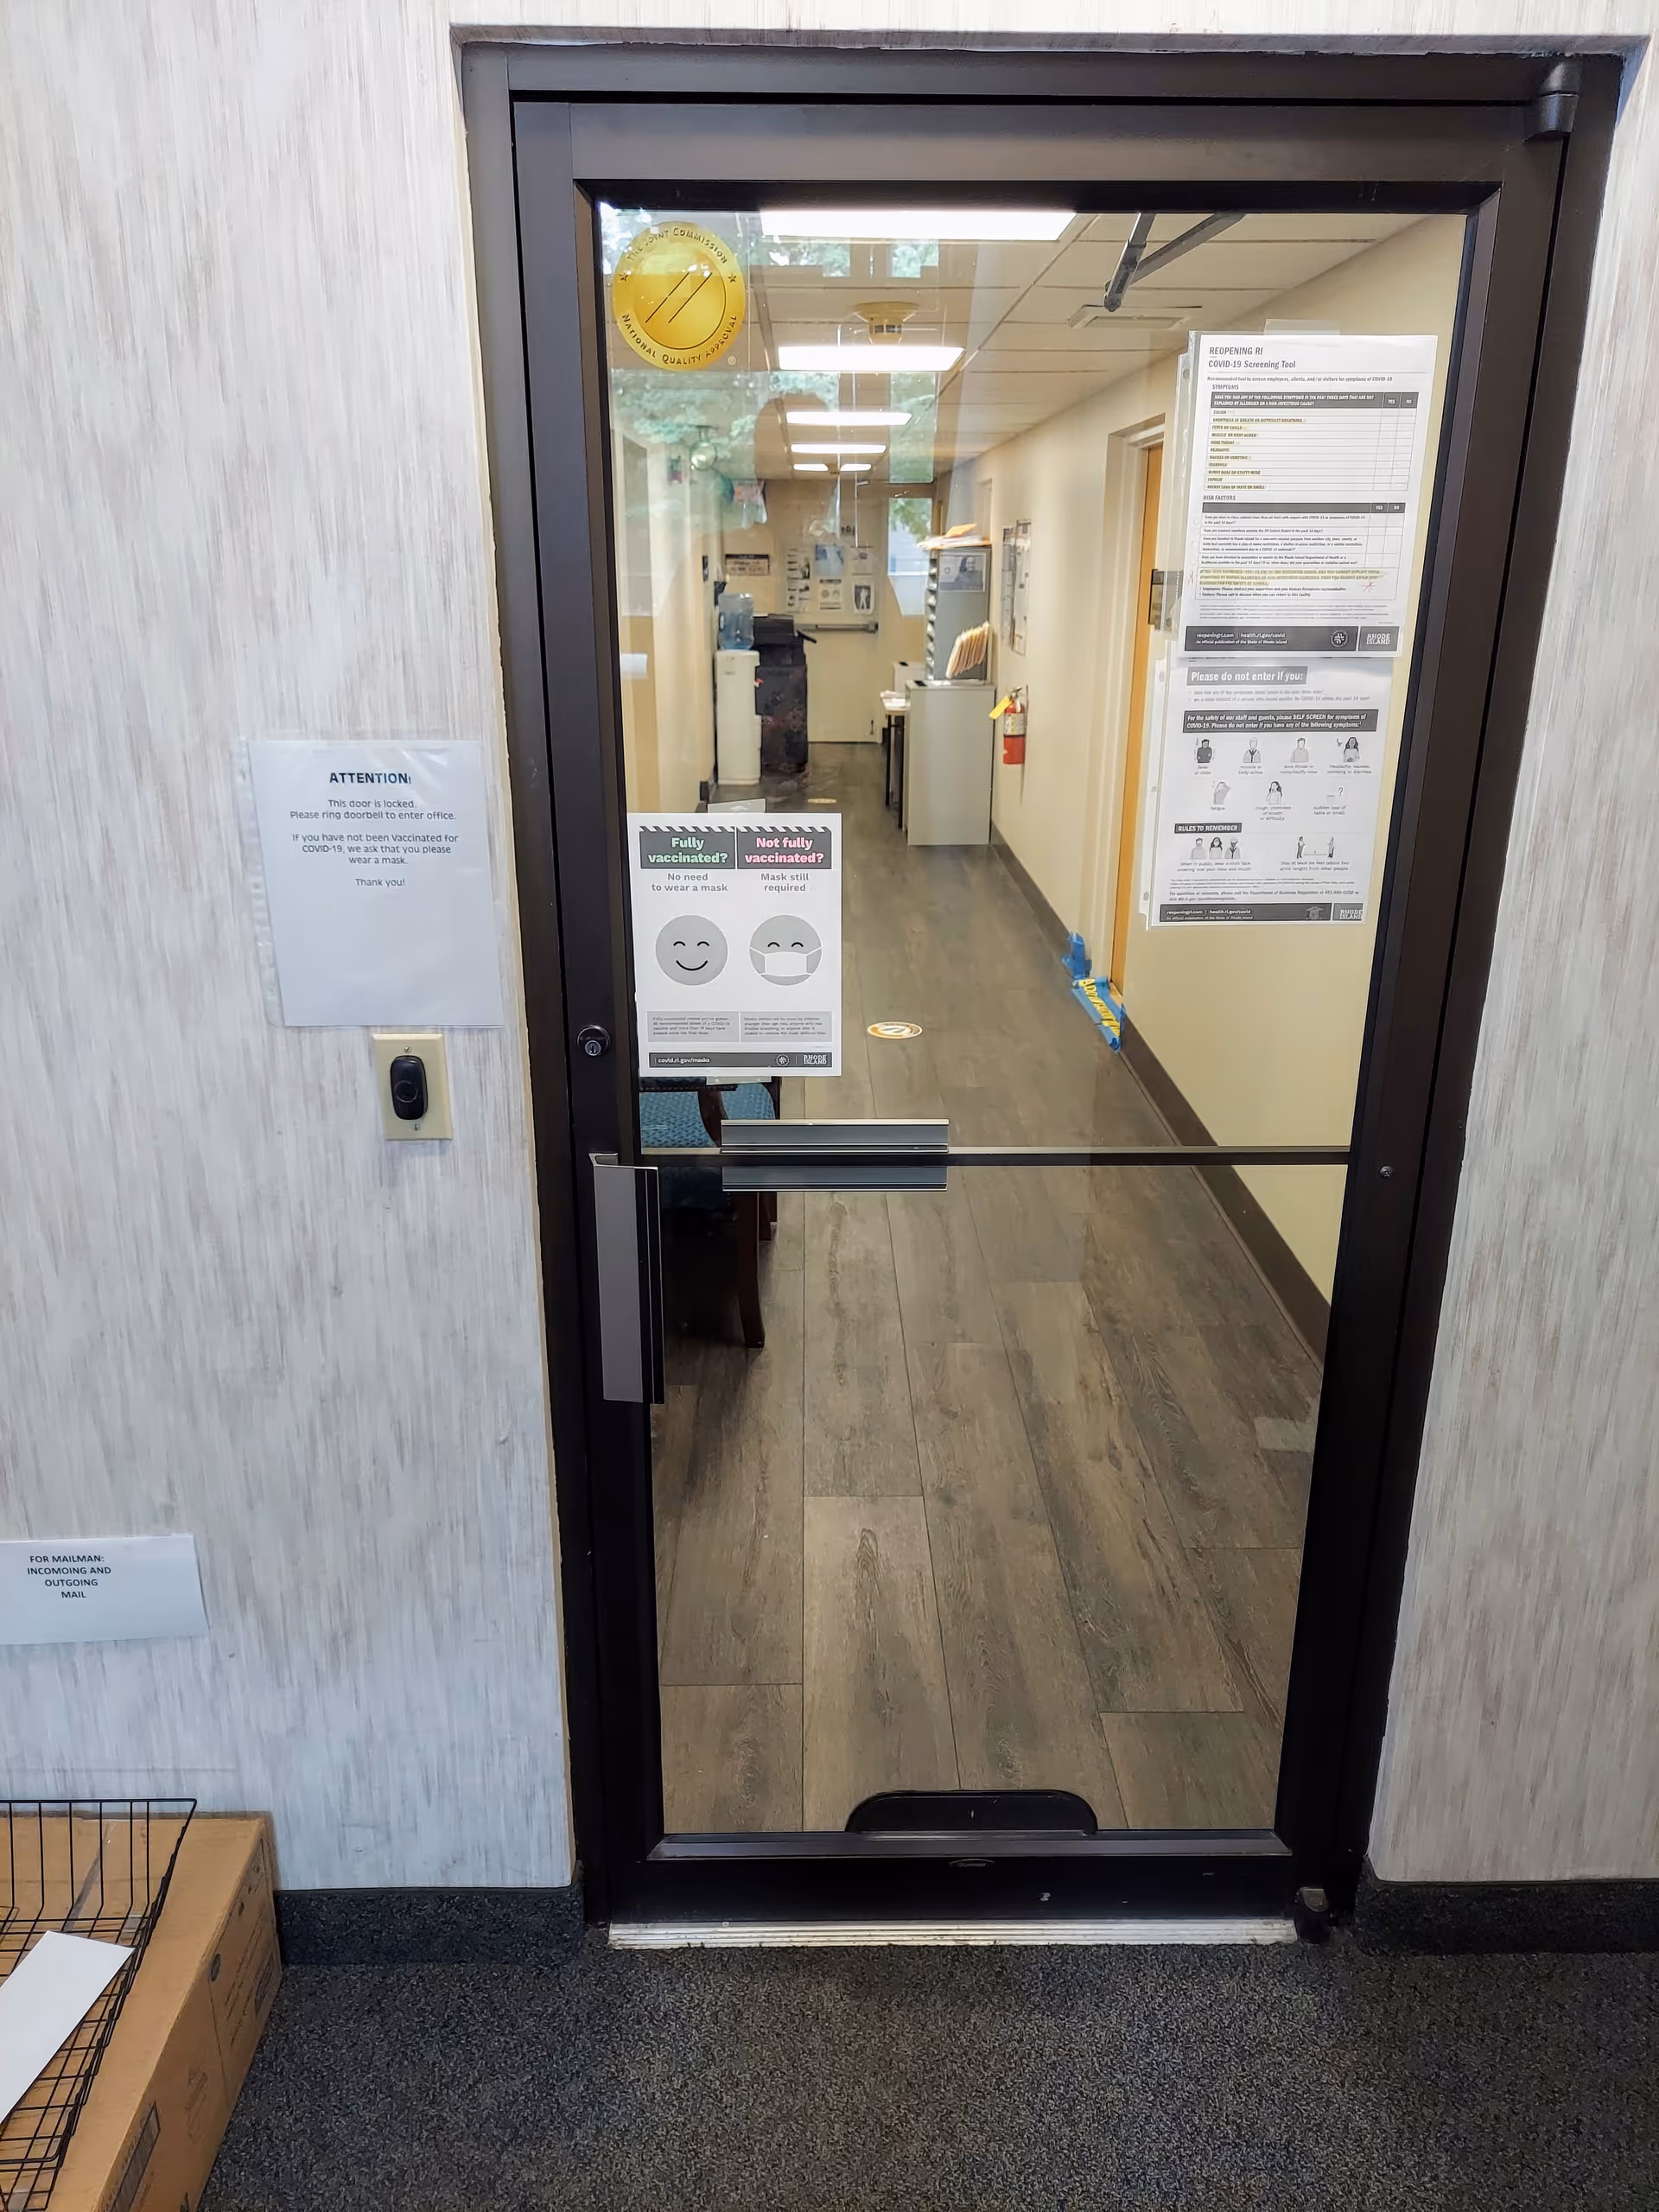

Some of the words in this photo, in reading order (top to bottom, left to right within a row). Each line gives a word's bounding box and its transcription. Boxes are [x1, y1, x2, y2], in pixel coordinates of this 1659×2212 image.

[673, 227, 728, 264] COMMISSION
[622, 314, 657, 358] NATIONAL
[662, 353, 702, 365] QUALITY
[1244, 360, 1279, 370] Screening
[1192, 671, 1218, 681] Please
[1221, 671, 1232, 681] do
[1235, 671, 1249, 681] not
[1252, 671, 1275, 681] enter
[1285, 673, 1303, 683] you:
[328, 799, 346, 808] This
[349, 799, 372, 808] door
[374, 799, 381, 808] is
[384, 799, 416, 808] locked.
[290, 811, 320, 820] Please
[322, 811, 340, 820] ring
[344, 811, 383, 820] doorbell
[385, 811, 396, 820] to
[399, 811, 423, 820] enter
[427, 811, 456, 820] office.
[292, 833, 299, 842] If
[302, 833, 320, 842] you
[322, 833, 344, 842] have
[347, 833, 363, 842] not
[365, 833, 389, 842] been
[391, 833, 442, 842] Vaccinated
[445, 833, 459, 842] for
[671, 837, 705, 850] Fully
[756, 837, 779, 848] Not
[782, 837, 813, 851] fully
[302, 845, 346, 855] COVID-19,
[364, 845, 378, 854] ask
[380, 845, 399, 854] that
[422, 845, 451, 854] please
[648, 852, 728, 863] vaccinated?
[745, 853, 823, 863] vaccinated?
[355, 878, 383, 887] Thank
[385, 878, 405, 887] you!
[764, 884, 805, 893] required
